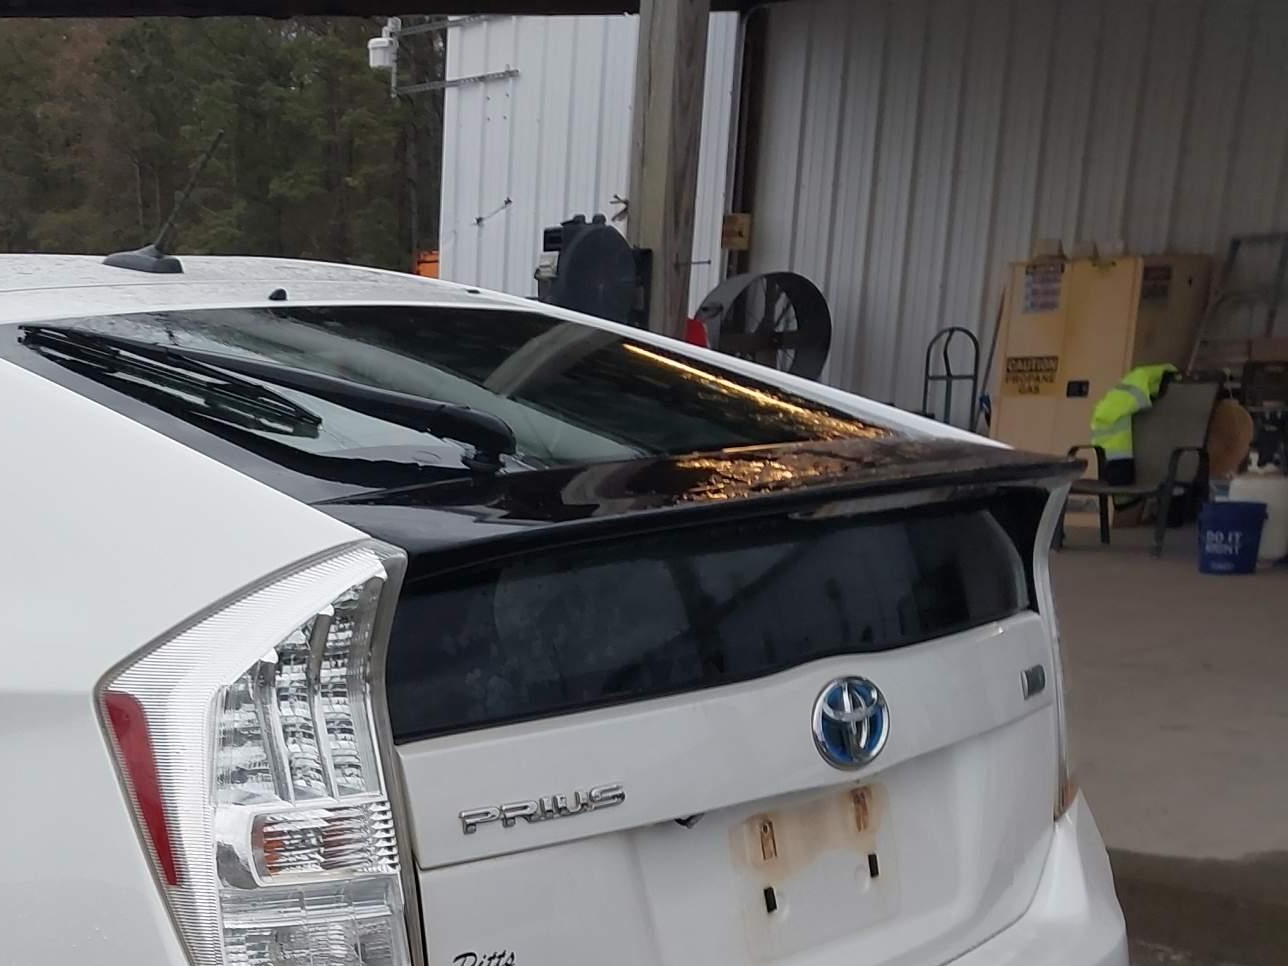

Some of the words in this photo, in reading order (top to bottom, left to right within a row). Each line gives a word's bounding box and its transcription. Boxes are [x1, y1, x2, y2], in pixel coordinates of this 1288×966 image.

[1008, 358, 1056, 371] CAUTION
[1005, 373, 1054, 384] PROPANE
[1018, 384, 1040, 394] GAS
[458, 784, 626, 835] PRIUS
